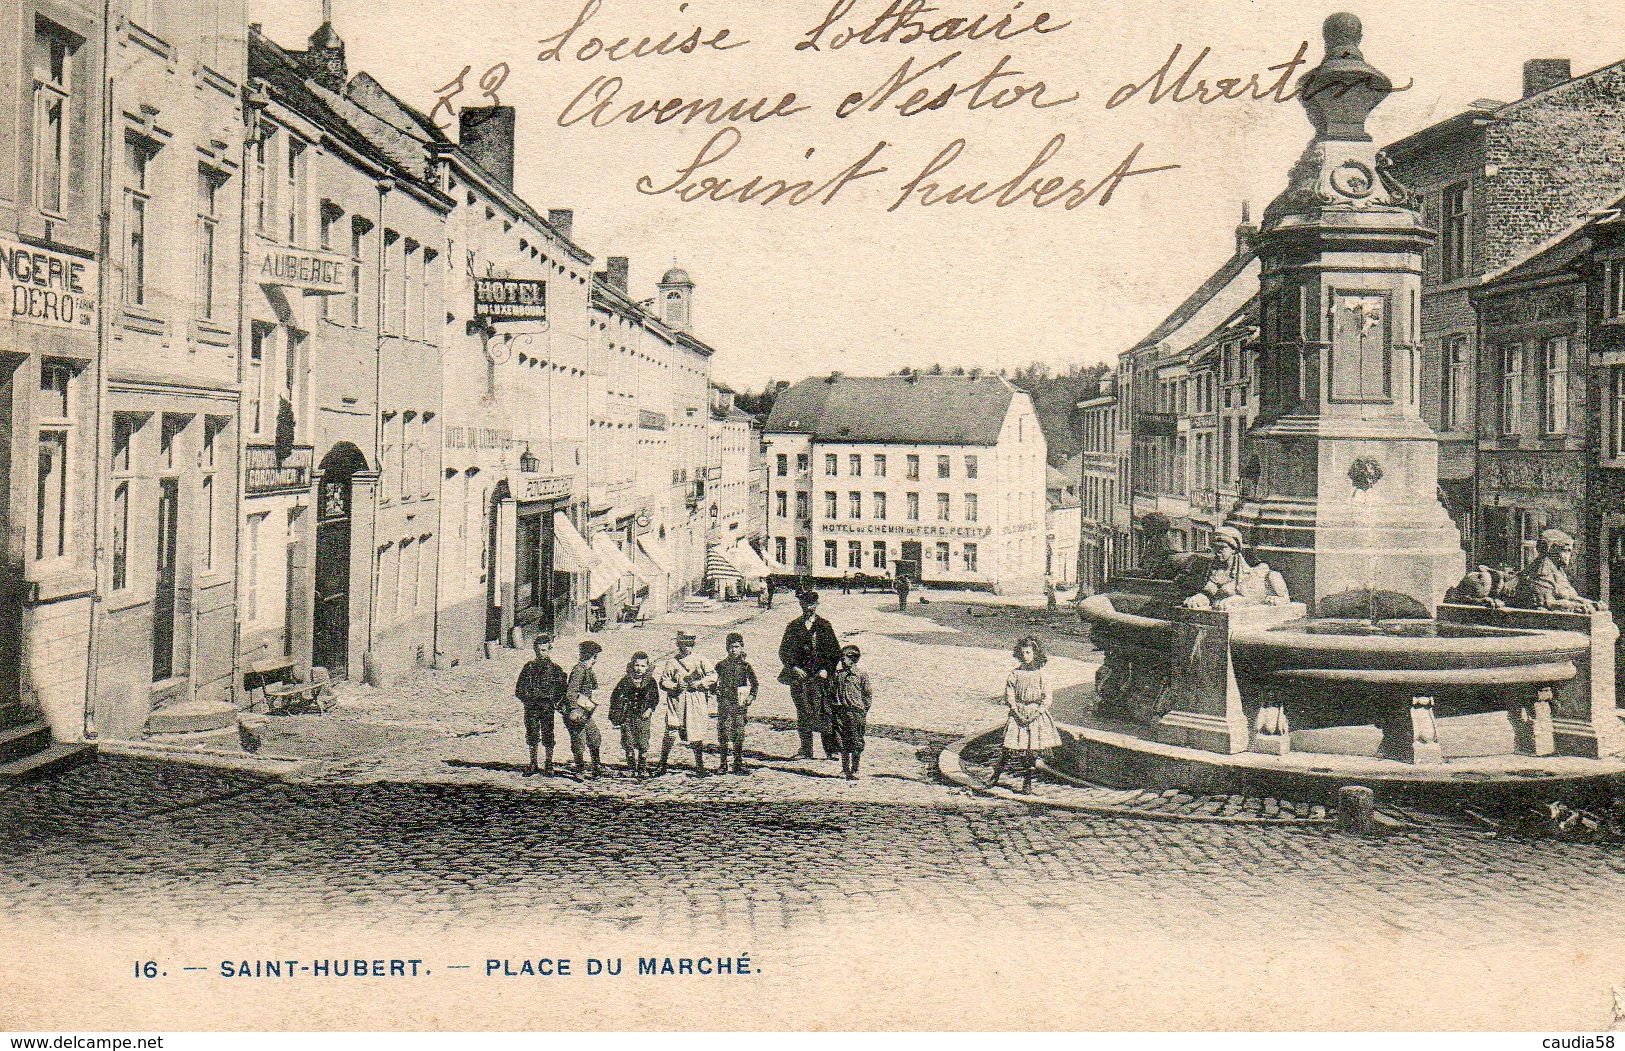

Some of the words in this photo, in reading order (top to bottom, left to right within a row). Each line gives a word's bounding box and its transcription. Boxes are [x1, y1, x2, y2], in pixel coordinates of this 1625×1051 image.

[538, 0, 749, 61] Louise
[557, 75, 811, 127] Avenue
[1105, 43, 1413, 110] Martin
[636, 127, 887, 206] Saint
[260, 252, 344, 285] AUBERGE
[477, 281, 544, 304] HOTEL
[822, 524, 855, 534] HOTEL
[867, 525, 904, 534] CHEMIN
[916, 526, 937, 535] FER
